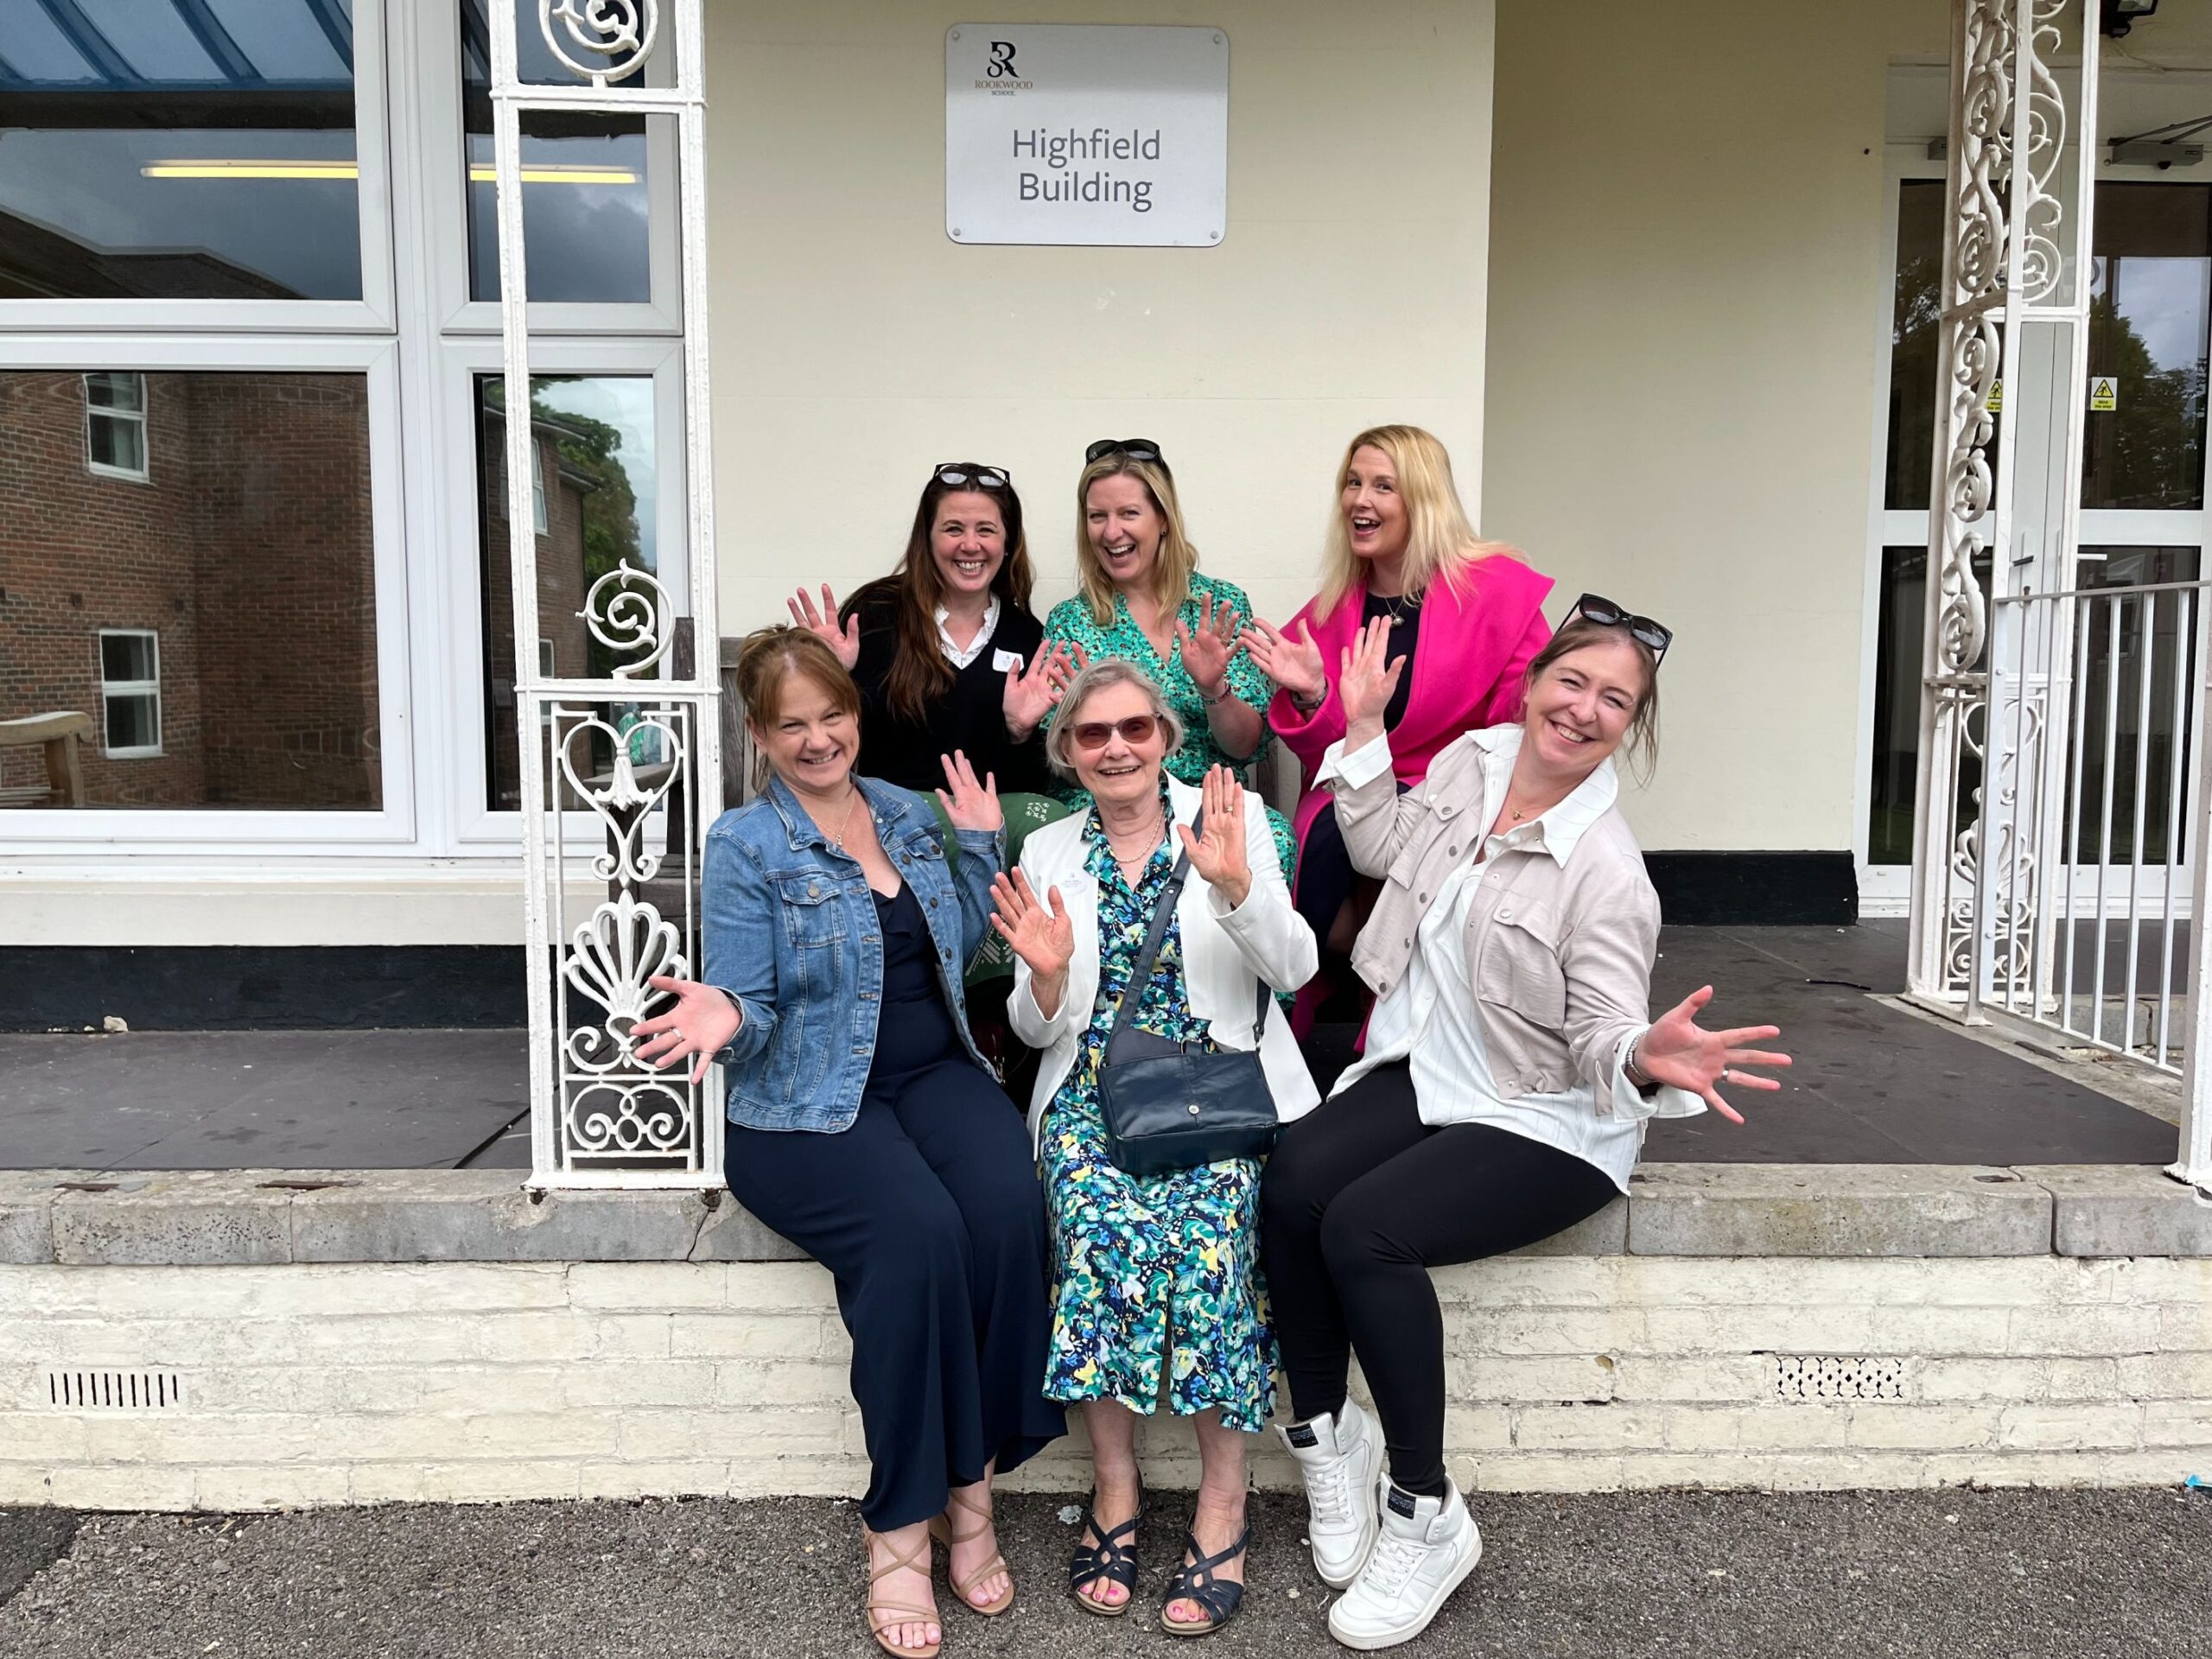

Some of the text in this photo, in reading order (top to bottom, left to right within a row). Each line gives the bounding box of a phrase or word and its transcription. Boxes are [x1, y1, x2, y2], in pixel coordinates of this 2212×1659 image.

[975, 79, 1033, 90] ROOKWOOD
[1013, 128, 1160, 169] Highfield
[1020, 171, 1153, 213] Building
